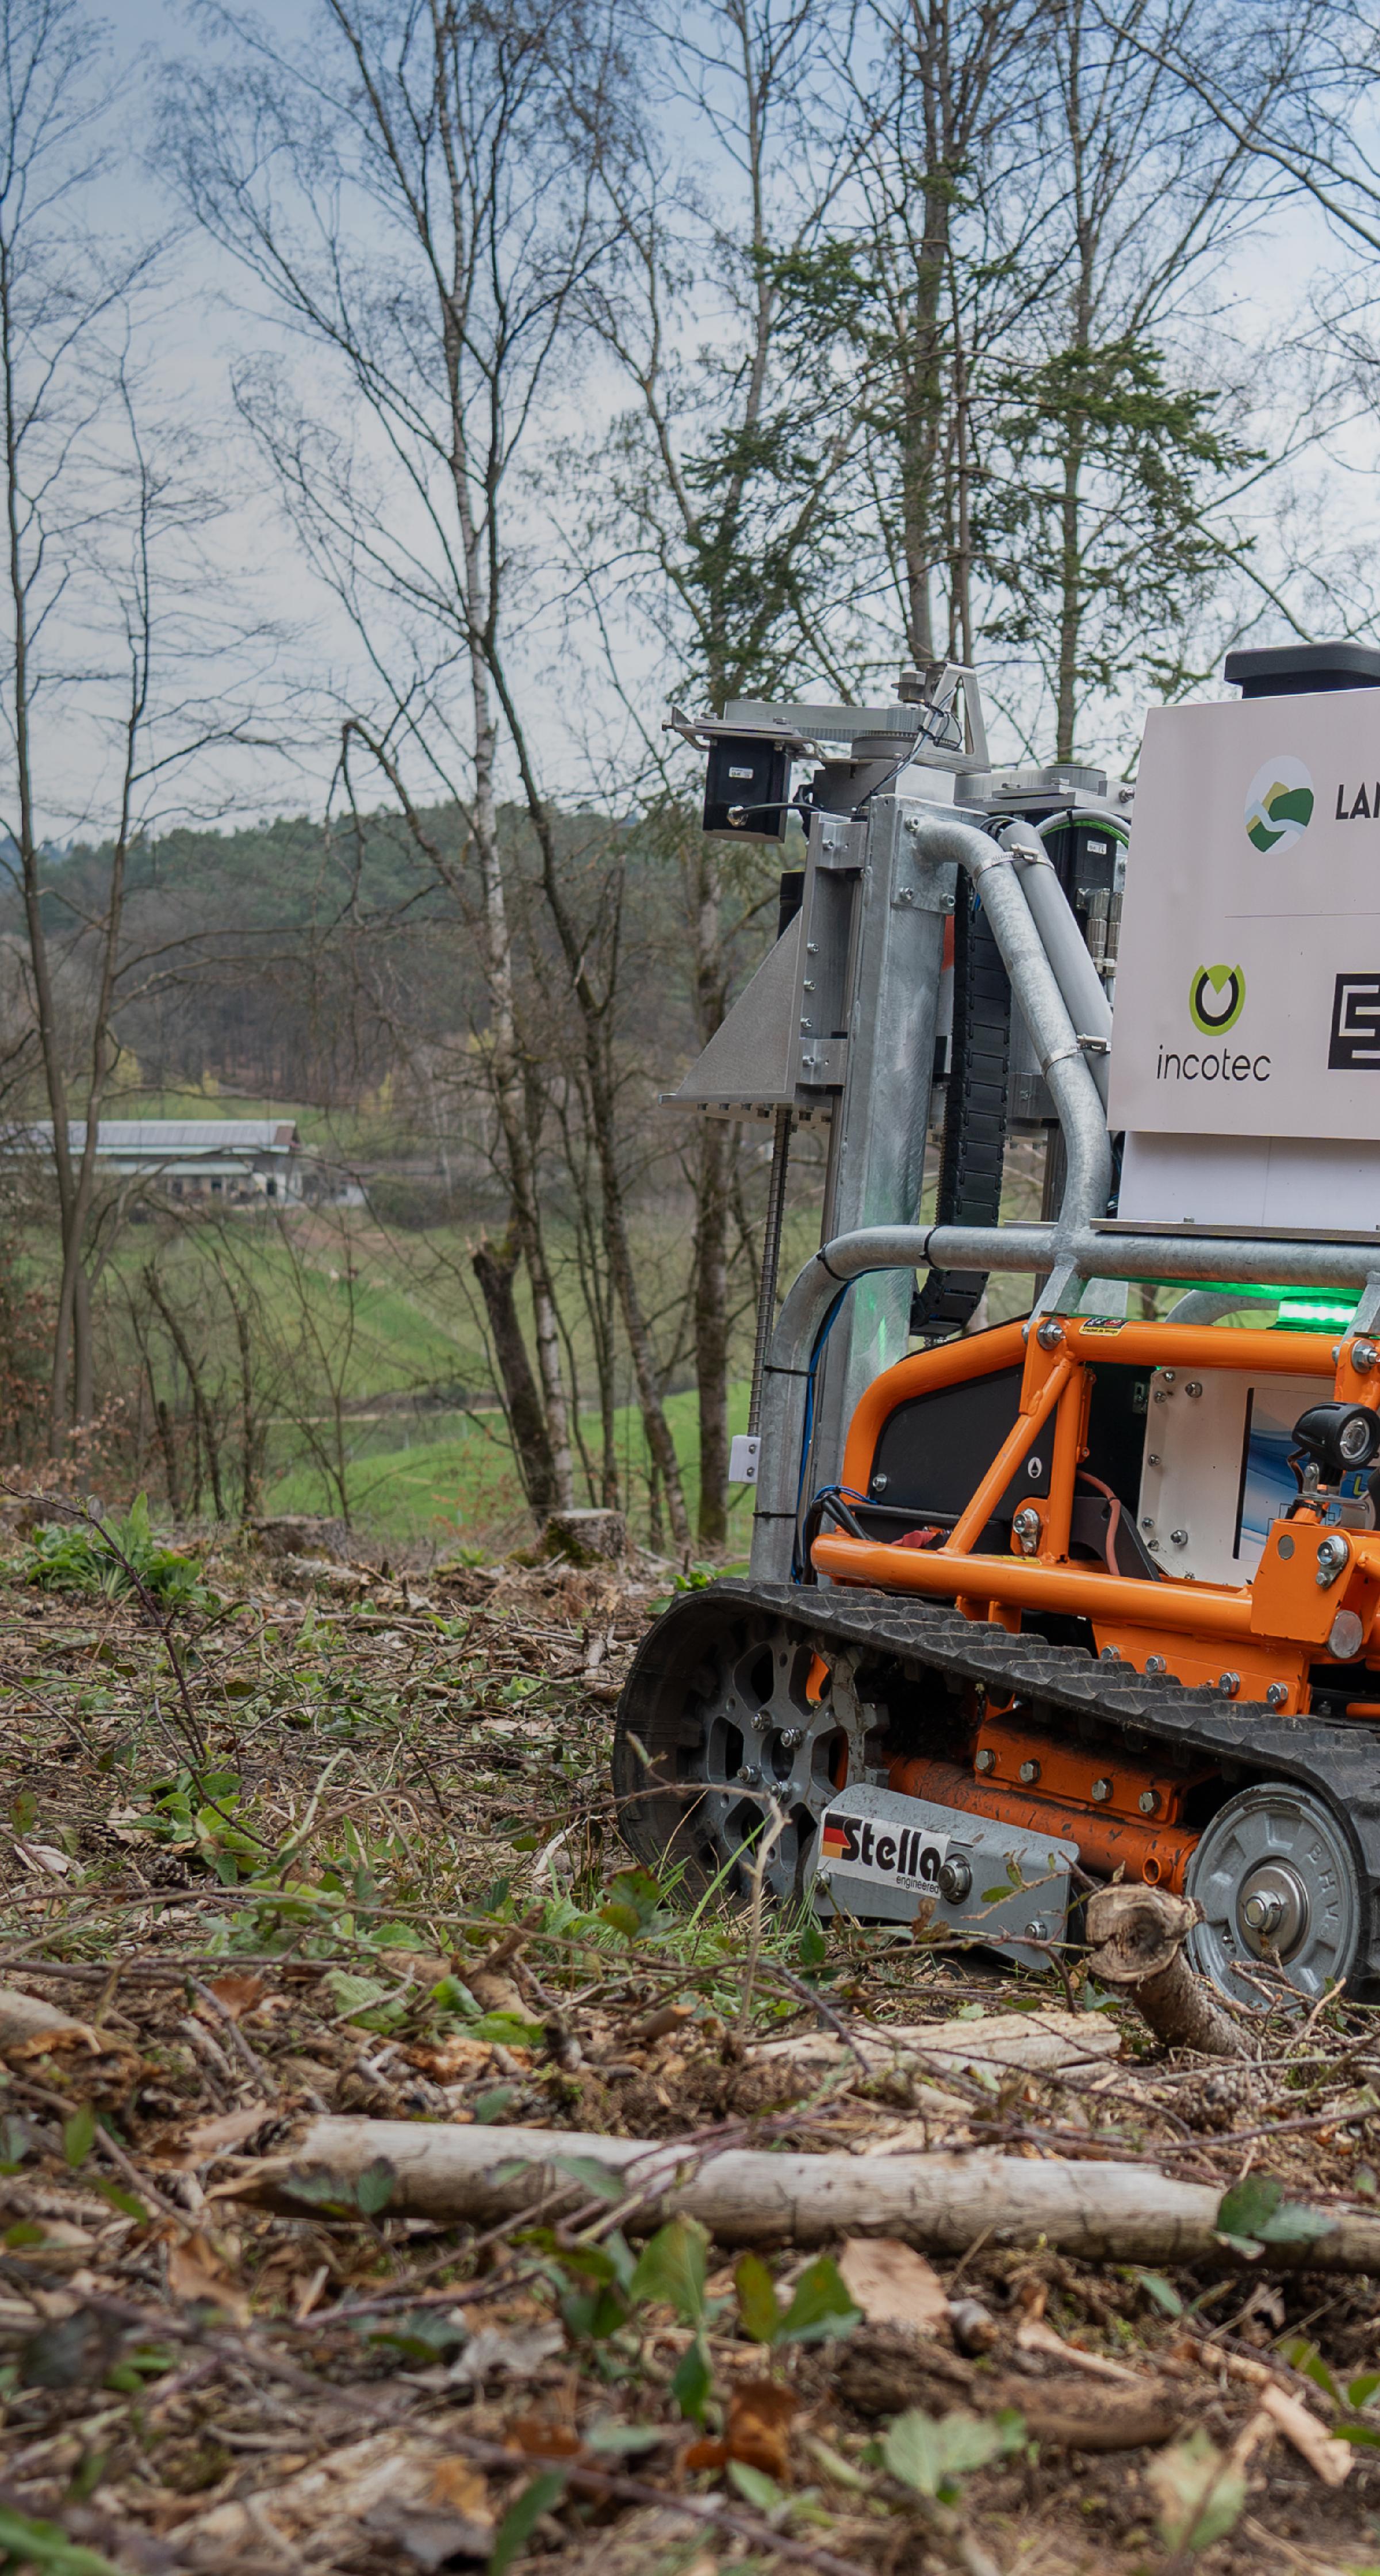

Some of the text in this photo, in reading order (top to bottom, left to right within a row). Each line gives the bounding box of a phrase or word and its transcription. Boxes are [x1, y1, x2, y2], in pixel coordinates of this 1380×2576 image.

[1156, 1044, 1271, 1081] incotec
[841, 1817, 942, 1881] Stella
[896, 1875, 940, 1894] engineered
